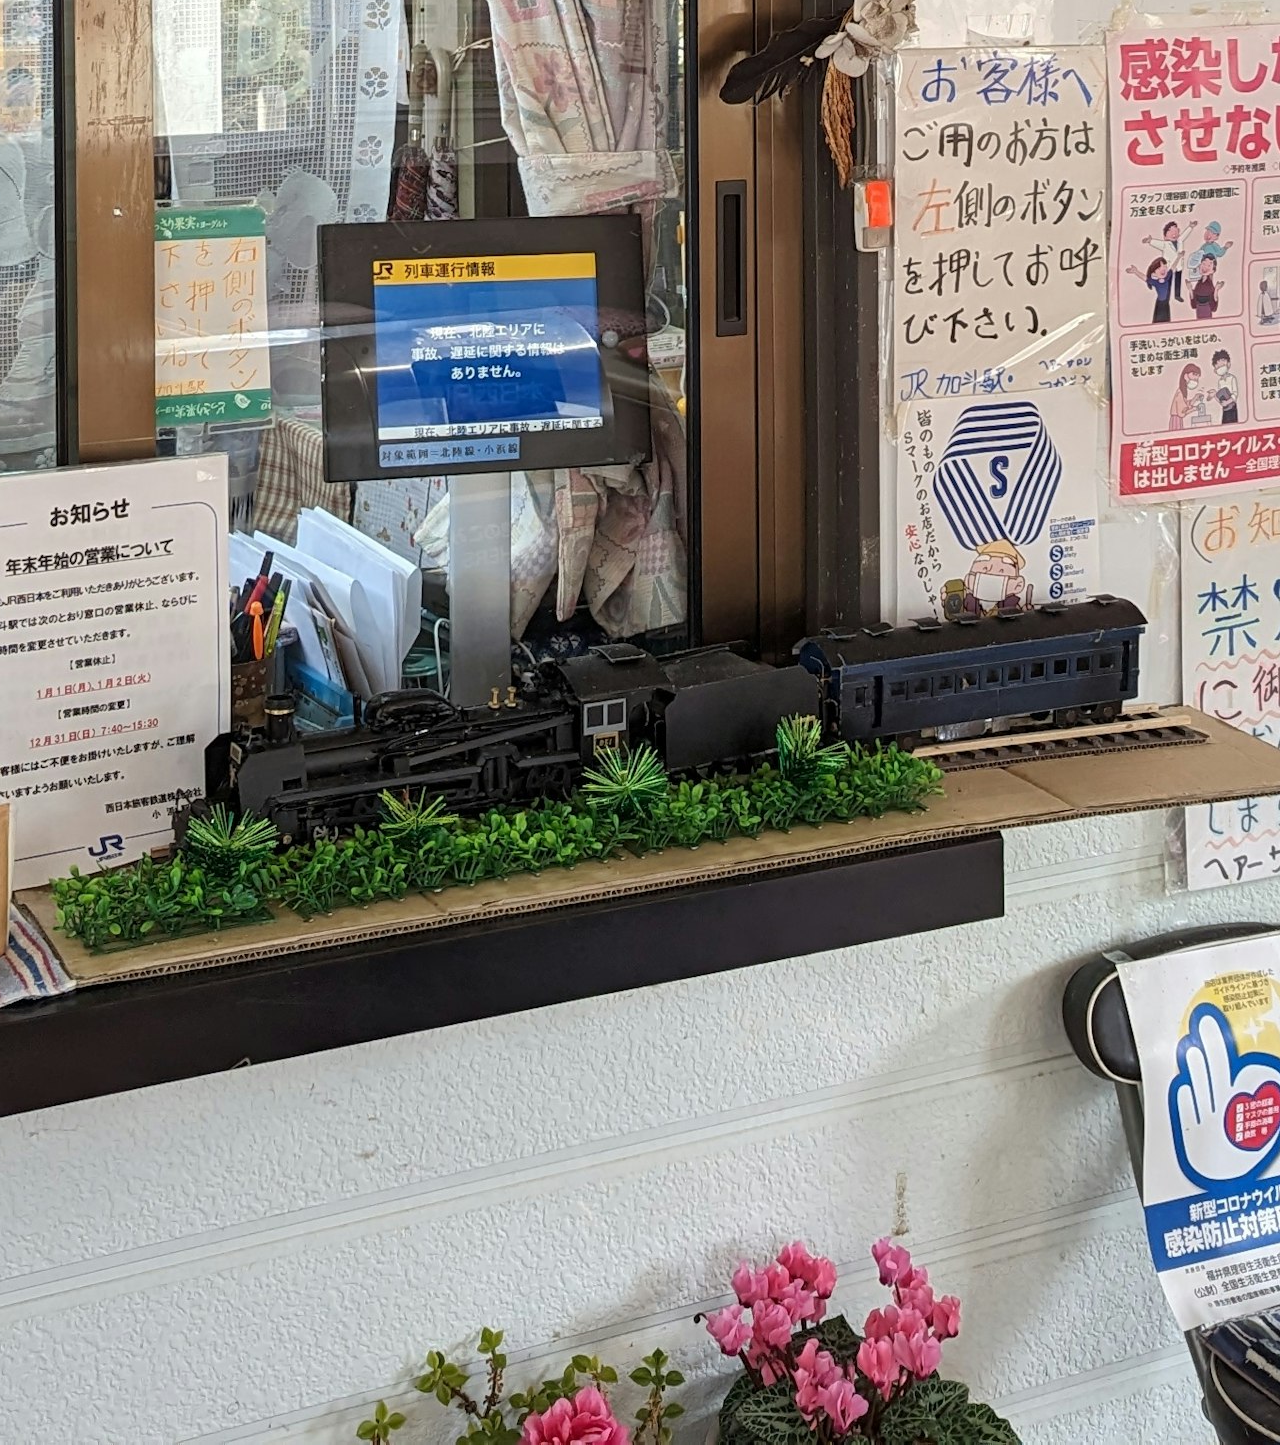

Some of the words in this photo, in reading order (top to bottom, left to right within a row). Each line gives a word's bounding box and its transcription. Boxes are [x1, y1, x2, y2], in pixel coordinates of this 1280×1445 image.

[903, 117, 1095, 167] ご用のお方は
[912, 178, 1104, 239] 左側のボタン
[1129, 203, 1196, 218] 万全を尽くします
[373, 262, 393, 277] JR
[404, 261, 496, 279] 列車運行情報
[903, 237, 1102, 296] を押してお呼
[157, 242, 188, 368] 下さいね
[185, 241, 216, 371] を押して
[223, 238, 258, 390] 右側のボタン
[430, 321, 546, 341] 現在、北陸エリアに
[410, 340, 566, 362] 事故、遅延に関する情報は
[1130, 349, 1199, 365] こまめな衛生消毒
[450, 363, 522, 381] ありません。
[1131, 364, 1165, 378] をします
[916, 409, 936, 474] 皆のもの
[1132, 456, 1232, 491] は出しません
[49, 498, 130, 529] お知らせ
[5, 539, 174, 575] 年末年始の営業について
[88, 834, 126, 857] JR
